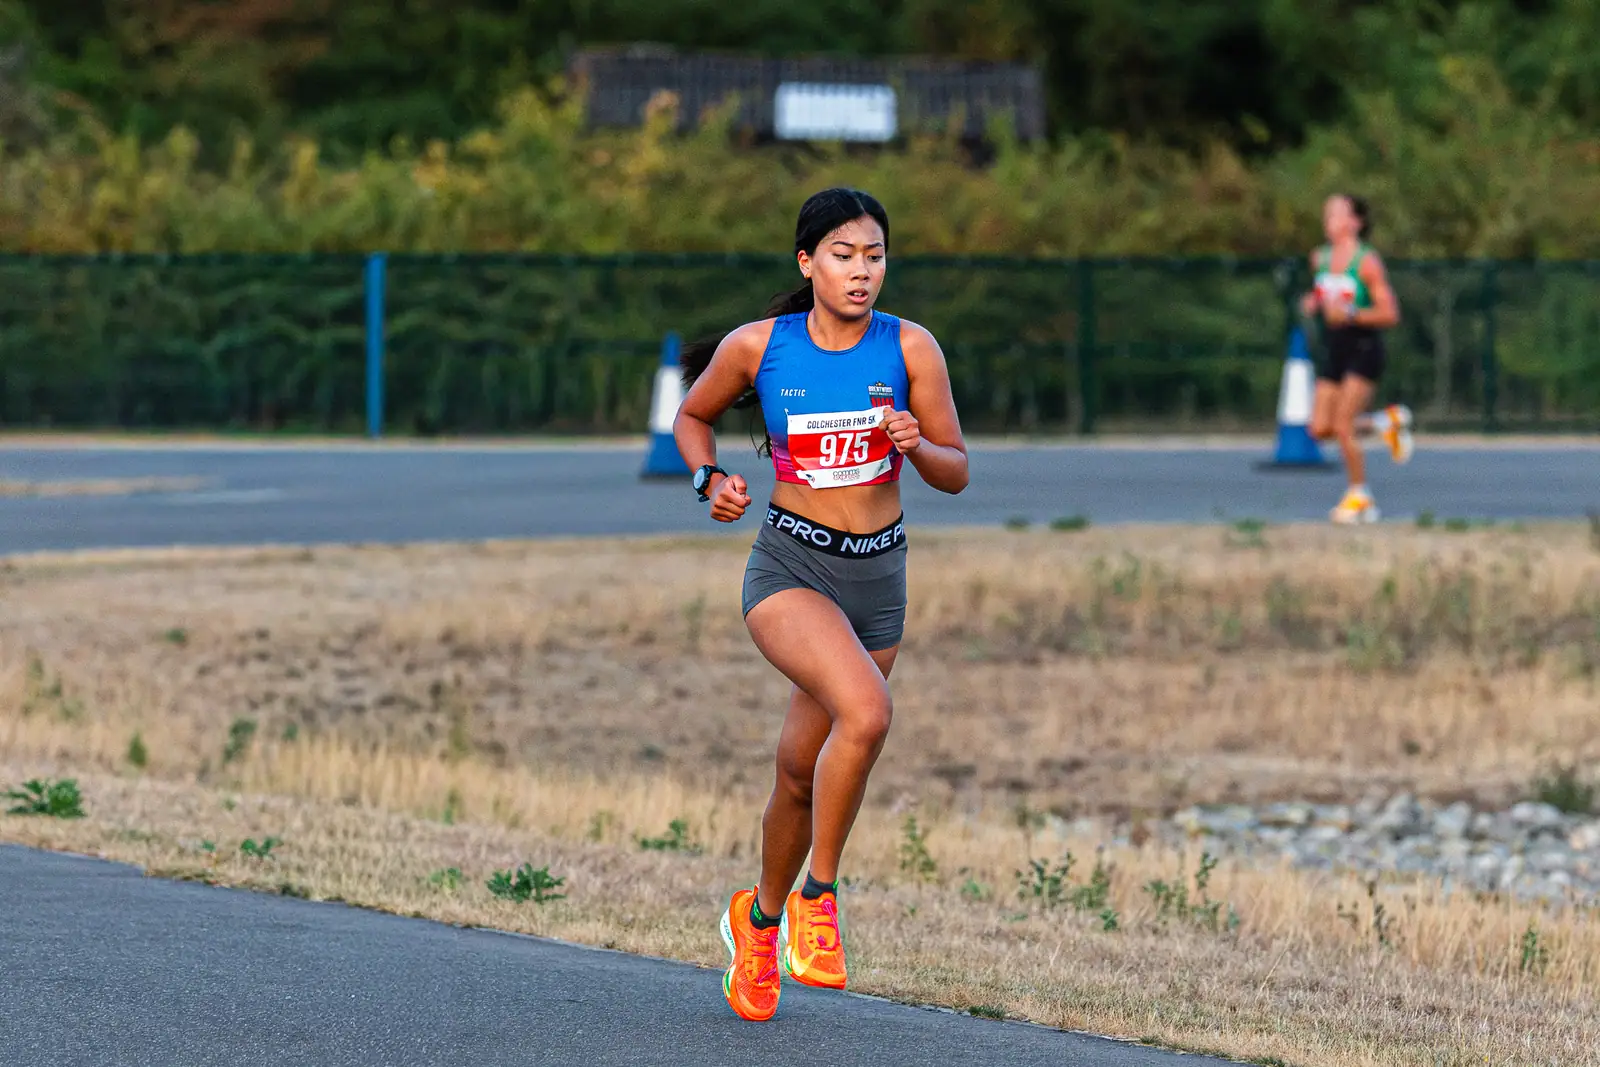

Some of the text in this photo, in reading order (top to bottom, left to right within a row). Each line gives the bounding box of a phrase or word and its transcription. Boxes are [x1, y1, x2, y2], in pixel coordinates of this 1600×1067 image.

[780, 388, 806, 397] TACTIC
[807, 415, 876, 429] COLCHESTER FNR 5K
[819, 431, 871, 467] 975
[776, 514, 832, 547] PRO
[840, 530, 893, 554] NIKE
